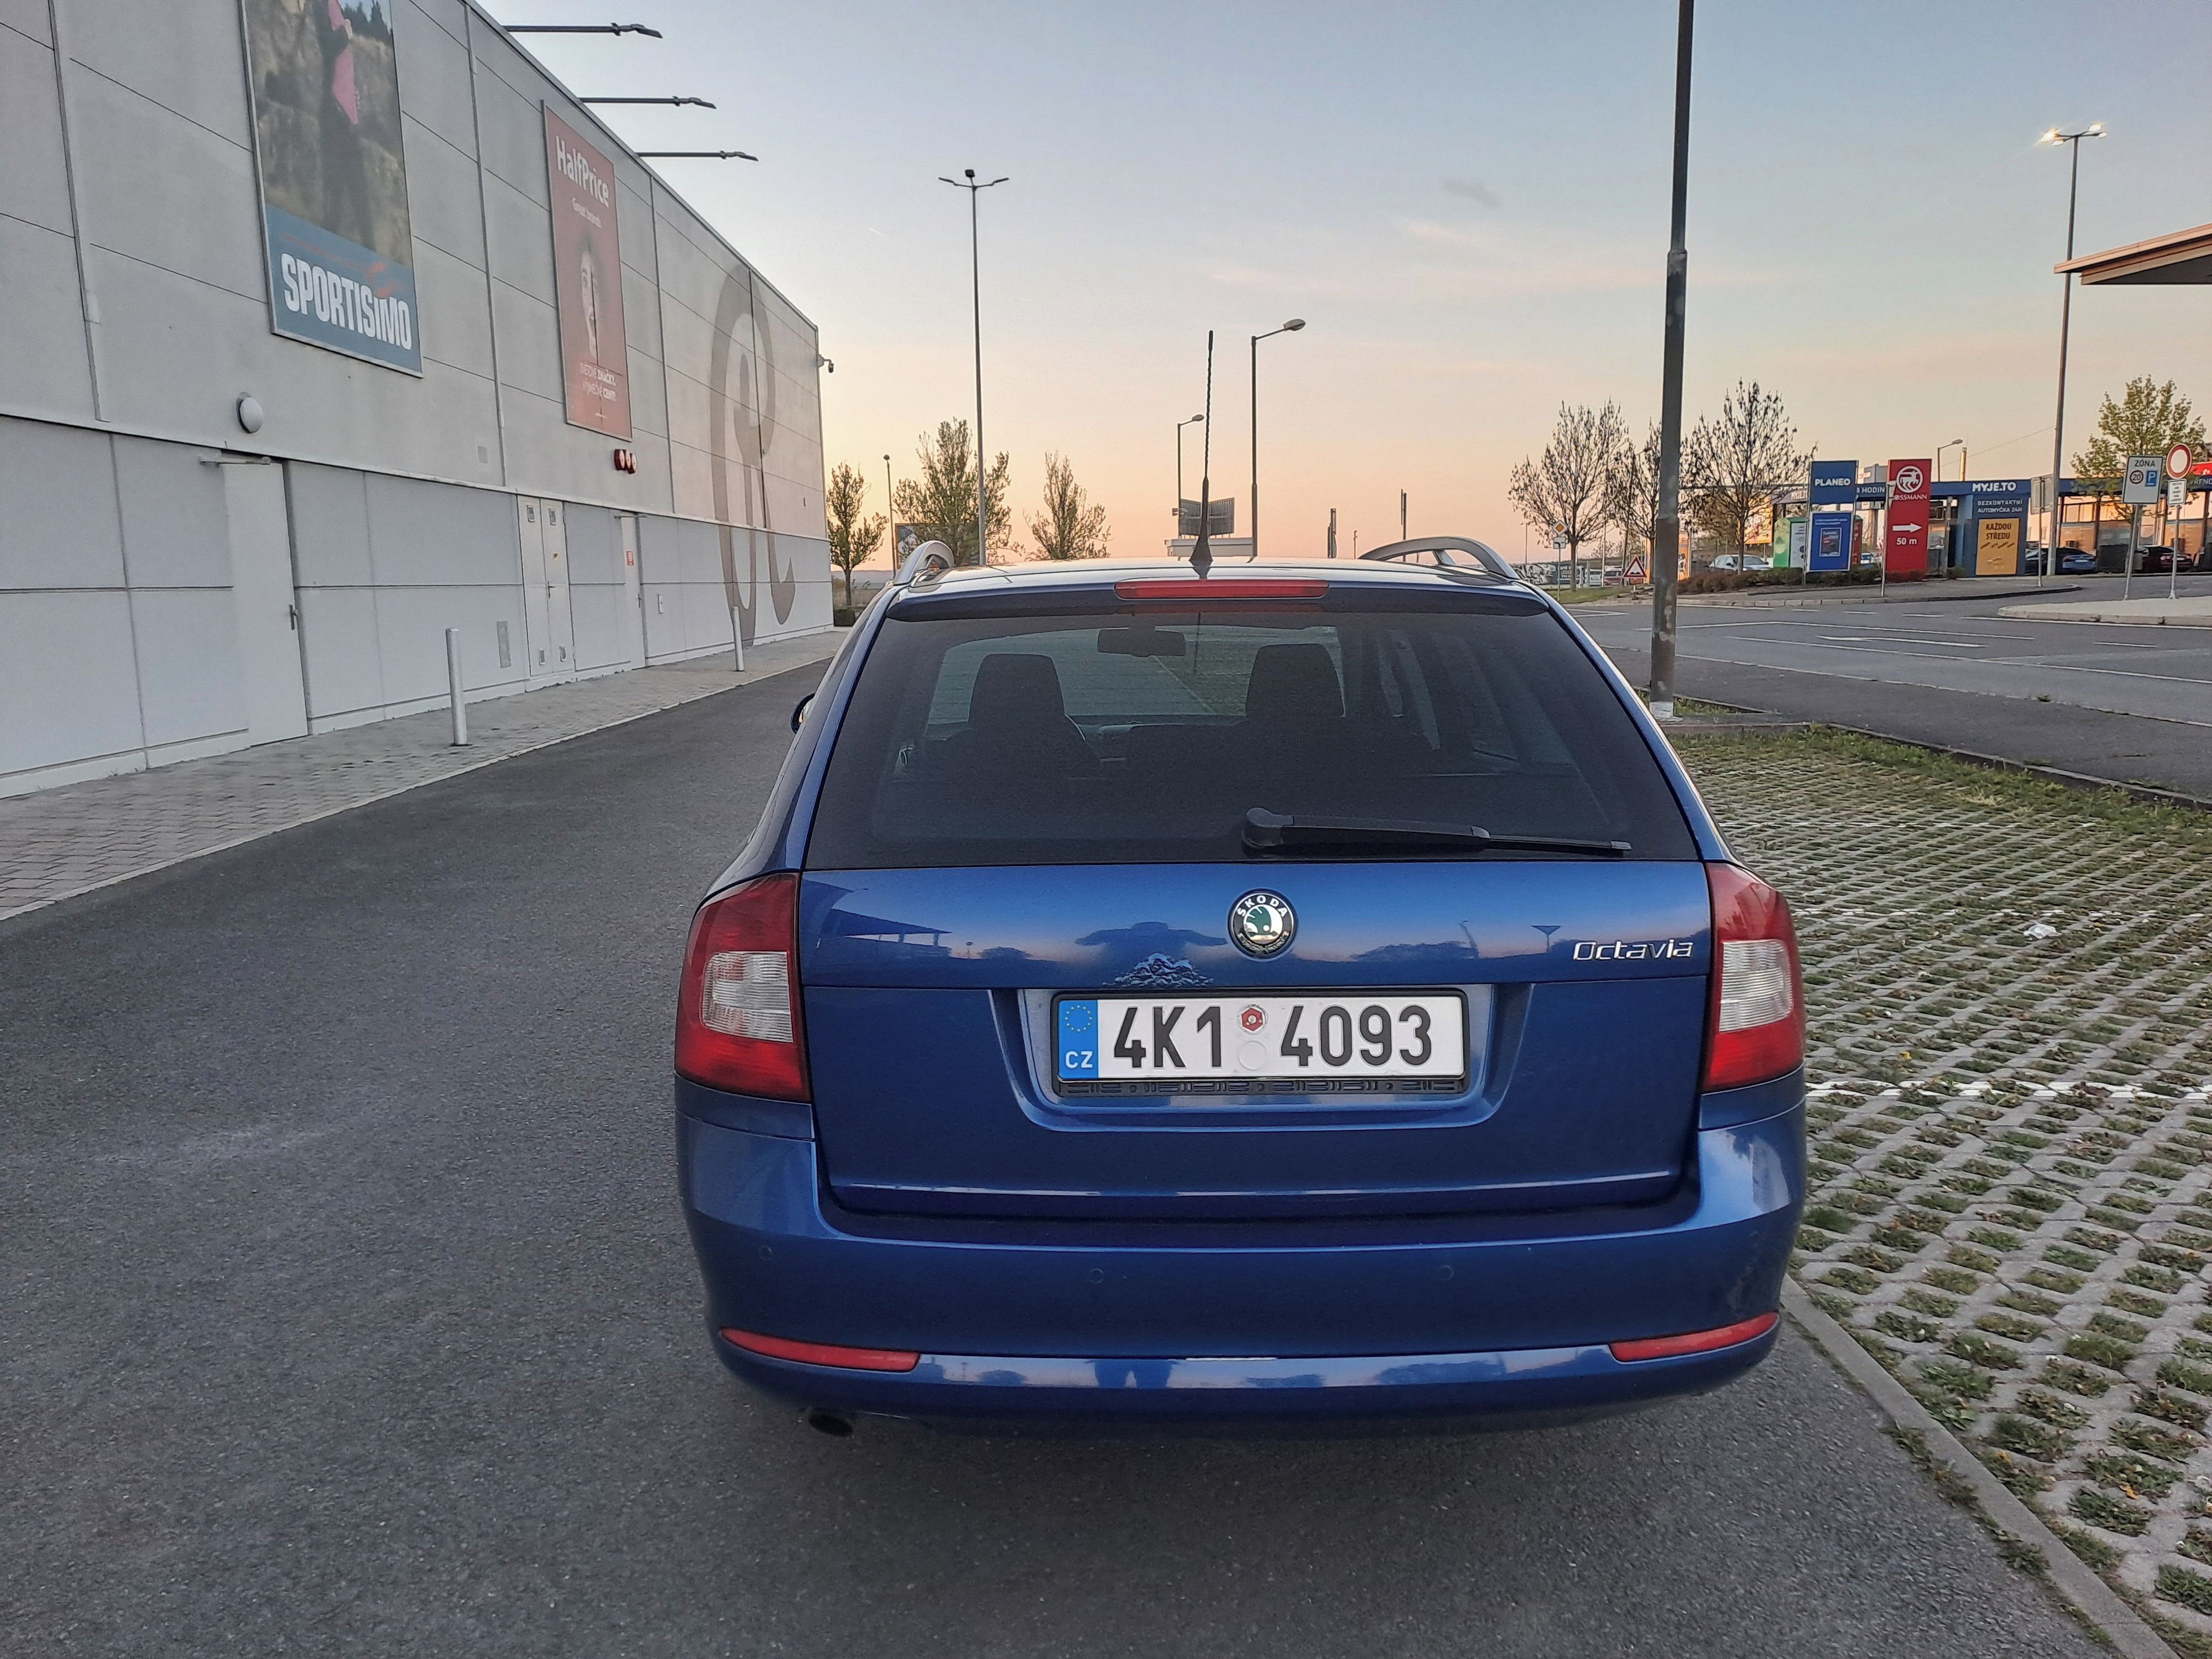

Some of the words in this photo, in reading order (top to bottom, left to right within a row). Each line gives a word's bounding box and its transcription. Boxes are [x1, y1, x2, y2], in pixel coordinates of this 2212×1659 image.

[556, 135, 609, 208] HalfPrice
[281, 253, 413, 351] SPORTISIMO
[2134, 458, 2156, 467] ZÓNA
[1814, 477, 1851, 487] PLANEO
[1972, 482, 2016, 492] MYJE.TO
[1896, 537, 1907, 545] 50
[1573, 939, 1694, 961] Octavia
[1114, 1006, 1222, 1068] 4K1
[1281, 1005, 1432, 1066] 4093
[1065, 1051, 1093, 1069] CZ
